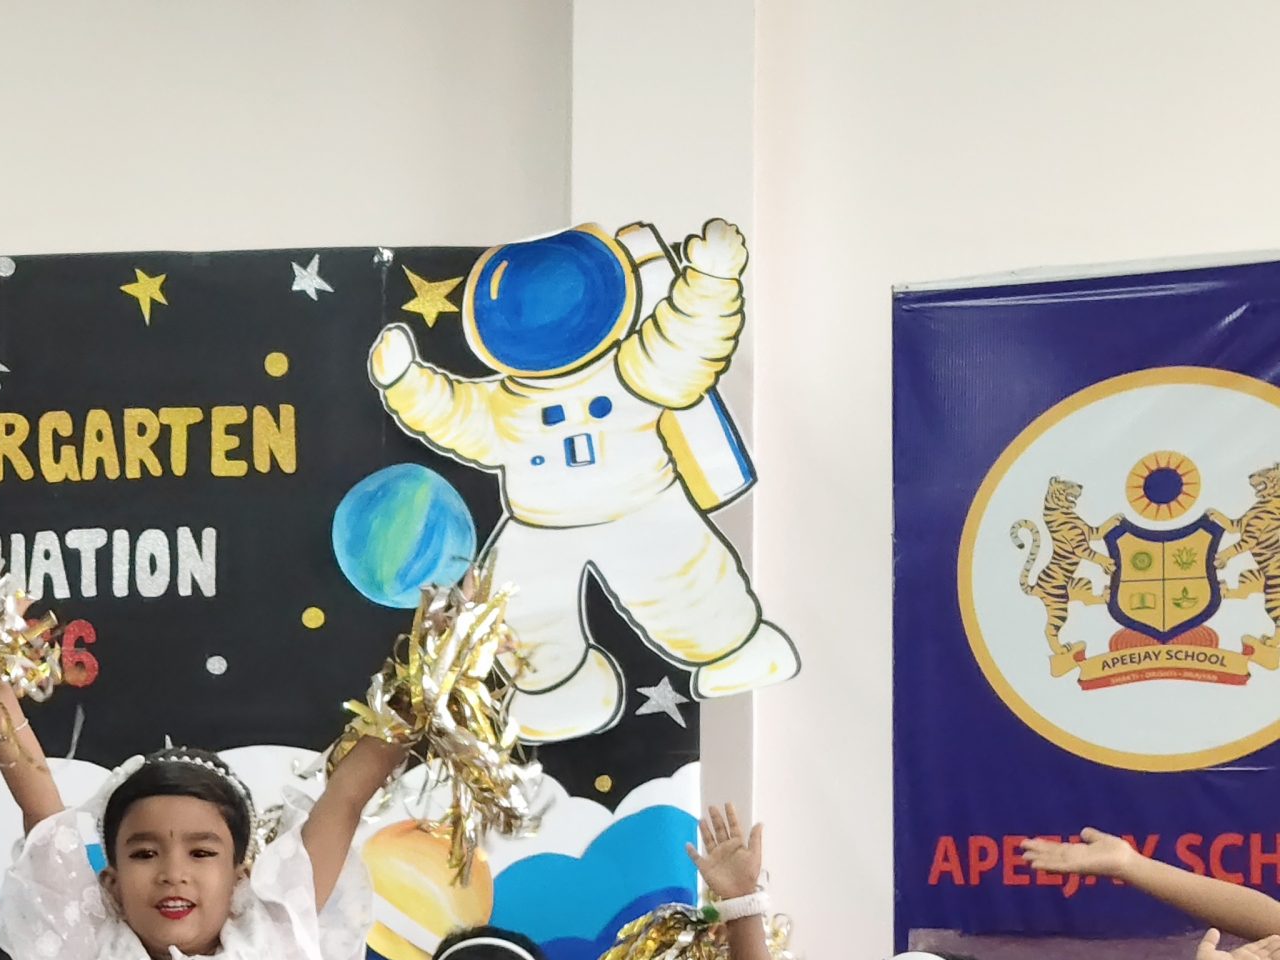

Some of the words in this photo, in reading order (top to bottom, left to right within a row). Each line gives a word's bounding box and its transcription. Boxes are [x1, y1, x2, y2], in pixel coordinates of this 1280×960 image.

[1101, 650, 1162, 671] APEEJAY
[1165, 649, 1228, 668] SCHOOL
[928, 833, 1160, 898] APEEJY
